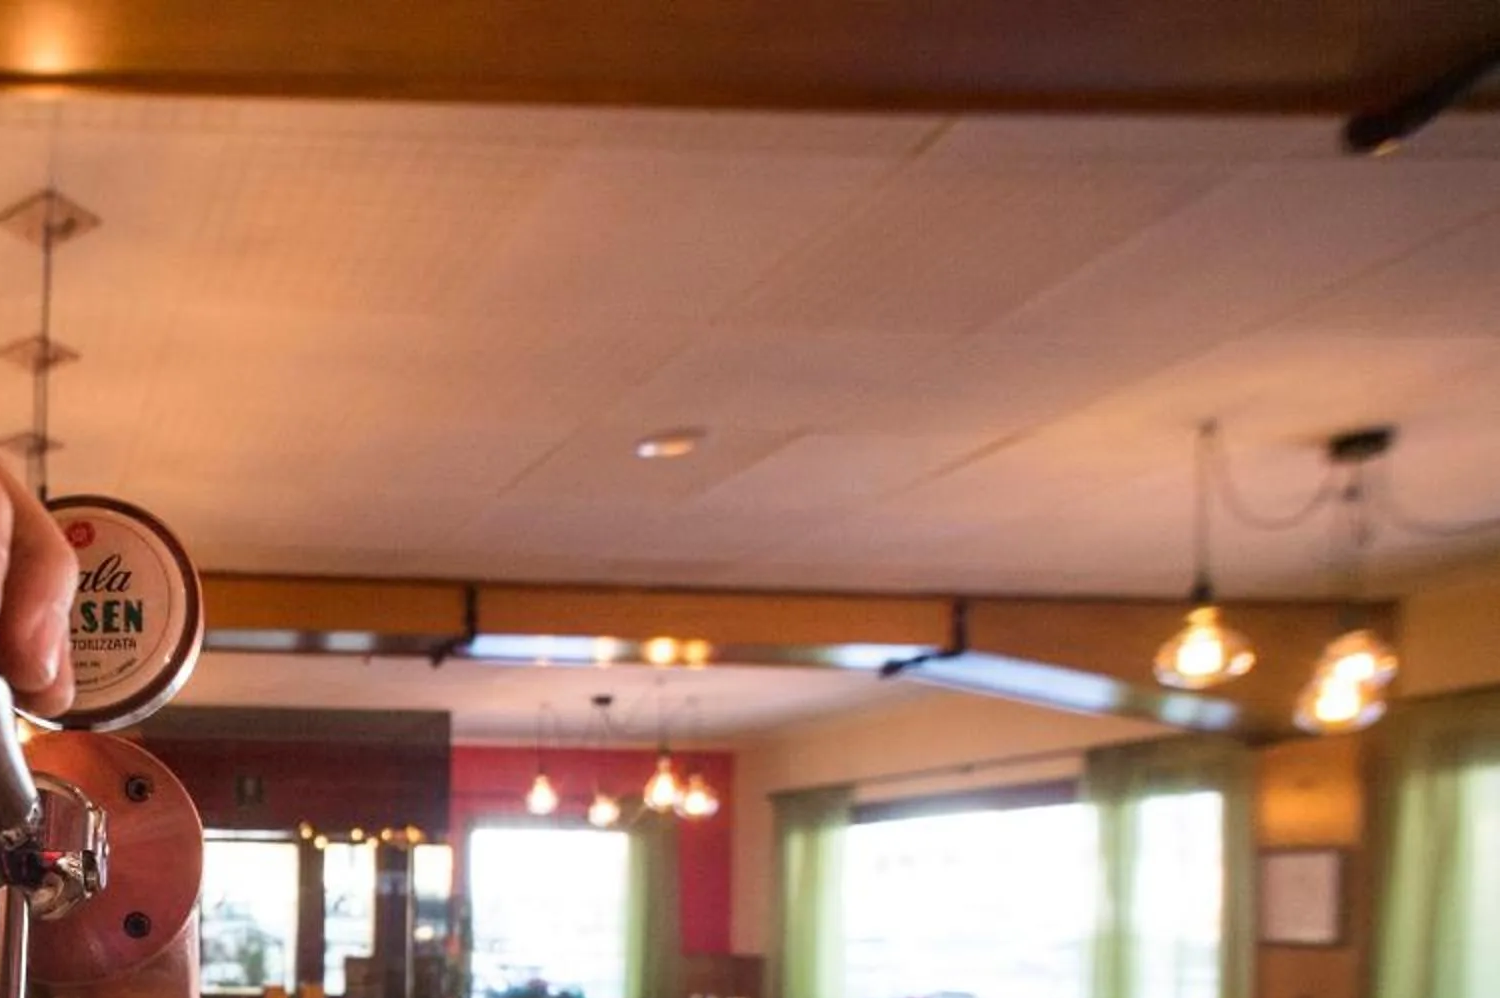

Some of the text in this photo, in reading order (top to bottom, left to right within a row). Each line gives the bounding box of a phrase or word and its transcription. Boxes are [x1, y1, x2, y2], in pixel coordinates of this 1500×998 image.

[78, 554, 132, 593] ala
[70, 599, 143, 634] SEN
[71, 636, 137, 651] TORIZZATA
